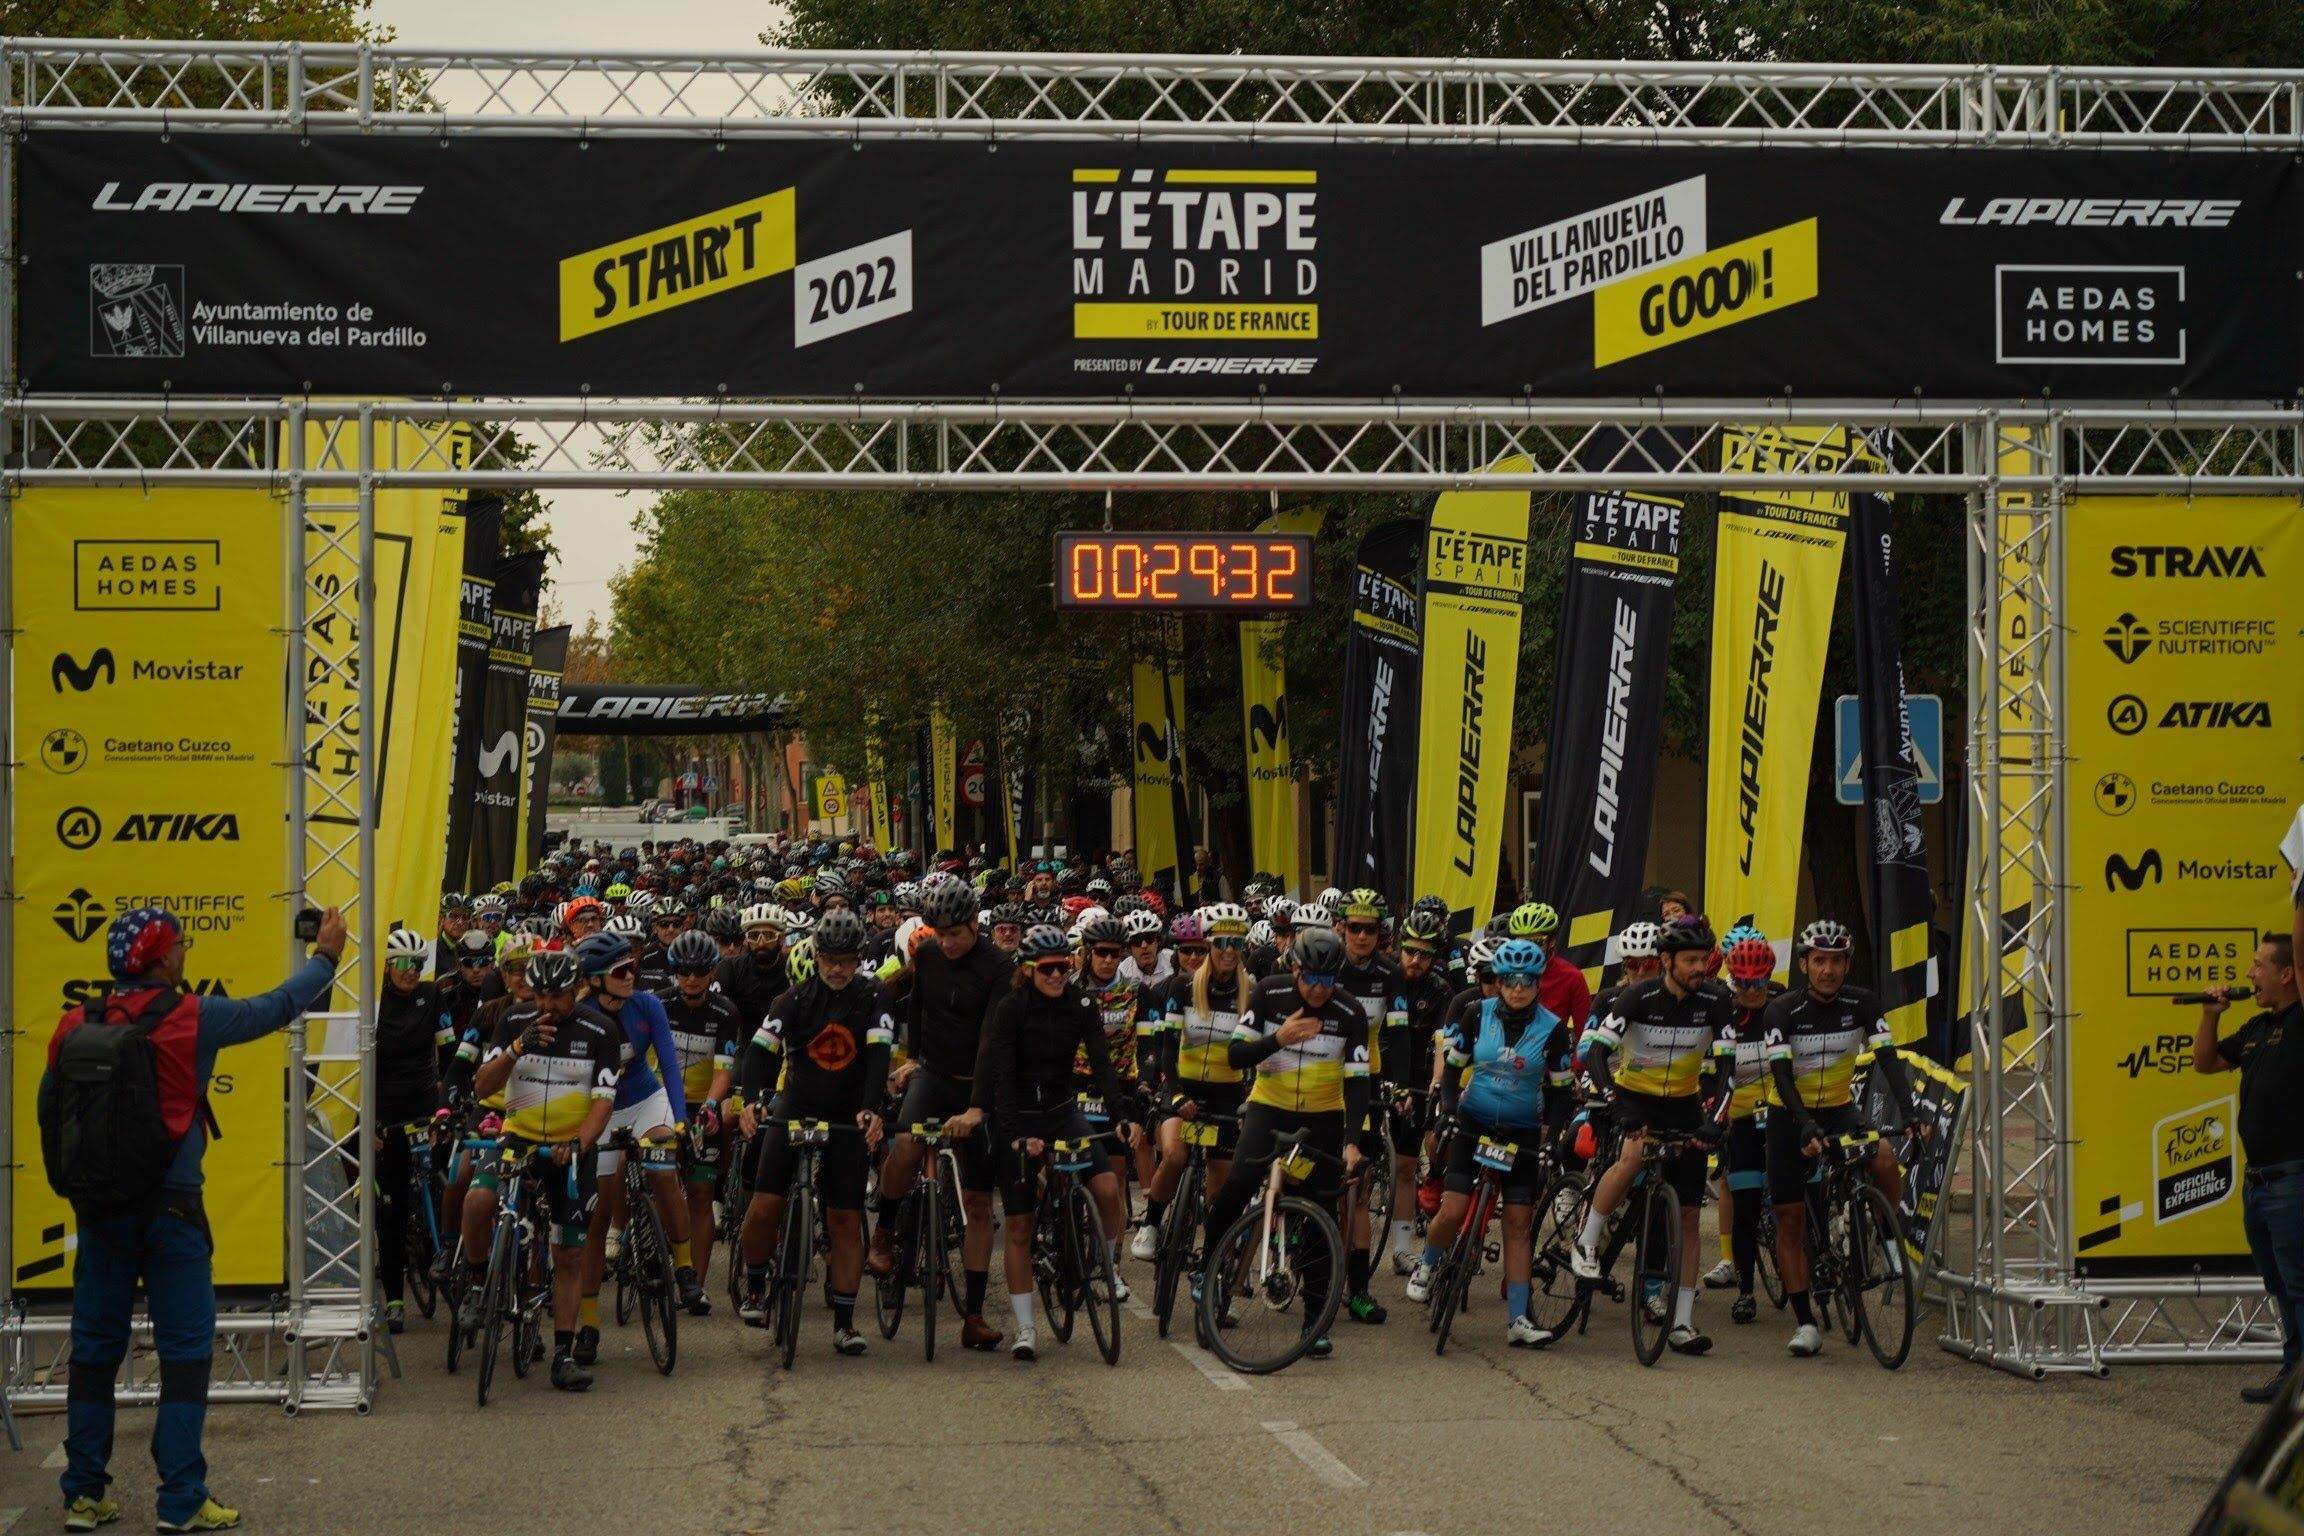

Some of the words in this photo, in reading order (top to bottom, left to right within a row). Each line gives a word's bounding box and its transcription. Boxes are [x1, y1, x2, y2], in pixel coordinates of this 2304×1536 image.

[92, 182, 425, 214] LAPIERRE
[1939, 198, 2242, 227] LAPIERRE
[1509, 196, 1667, 274] VILLANUEVA
[1073, 258, 1318, 296] MADRID
[1513, 265, 1557, 308] DEL
[1564, 225, 1684, 292] PARDILLO
[809, 256, 897, 325] 2022
[2026, 287, 2157, 311] AEDAS
[192, 301, 338, 324] Ayuntamiento
[346, 303, 373, 322] de
[1146, 319, 1159, 331] BY
[1161, 311, 1209, 331] TOUR
[1213, 311, 1236, 331] DE
[1240, 311, 1311, 332] FRANCE
[192, 325, 300, 347] Villanueva
[307, 325, 340, 346] del
[347, 326, 427, 347] Pardillo
[2026, 319, 2157, 343] HOMES
[1073, 358, 1128, 372] PRESENTED
[1129, 359, 1143, 371] BY
[1145, 357, 1318, 375] LAPIERRE
[1764, 505, 1787, 519] TOUR
[1788, 509, 1801, 521] DE
[1802, 511, 1840, 527] FRANCE
[1585, 523, 1679, 555] SPAIN
[98, 555, 198, 572] AEDAS
[1073, 544, 1297, 599] 00:29:32
[2110, 545, 2266, 578] STRAVA
[98, 579, 198, 596] HOMES
[1435, 562, 1522, 588] SPAIN
[2158, 620, 2276, 636] SCIENTIFFIC
[133, 659, 244, 680] Movistar
[1739, 559, 1785, 876] LAPIERRE
[2158, 702, 2272, 728] ATIKA
[104, 738, 174, 752] Caetano
[178, 738, 232, 752] Cuzco
[1590, 596, 1637, 878] LAPIERRE
[1454, 627, 1486, 877] LAPIERRE
[2151, 782, 2214, 796] Caetano
[2218, 782, 2266, 796] Cuzco
[112, 813, 241, 842] ATIKA
[2178, 859, 2278, 880] Movistar
[2148, 943, 2238, 959] AEDAS
[2148, 966, 2237, 982] HOMES
[2156, 1035, 2194, 1054] RP
[2165, 1178, 2227, 1210] EXPERIENCE
[2173, 1169, 2217, 1195] OFFICIAL
